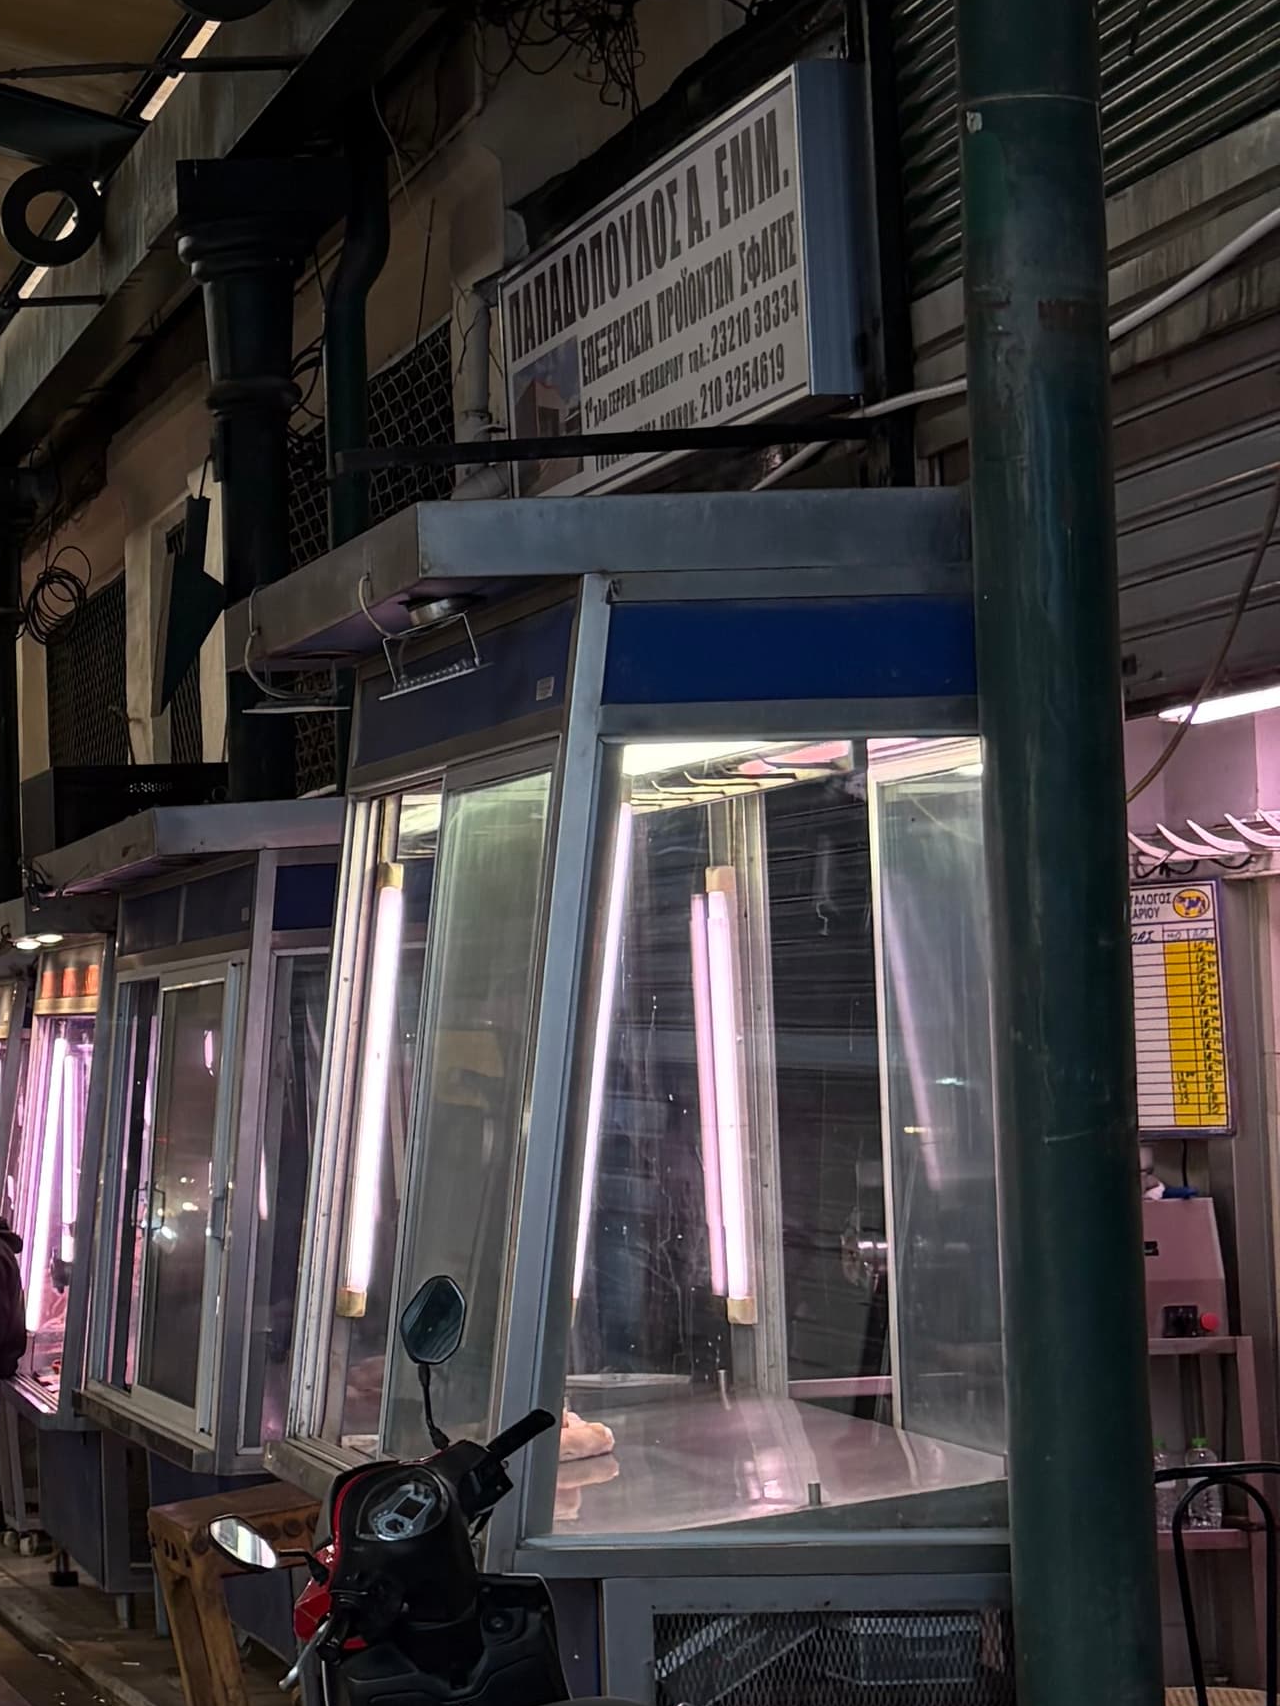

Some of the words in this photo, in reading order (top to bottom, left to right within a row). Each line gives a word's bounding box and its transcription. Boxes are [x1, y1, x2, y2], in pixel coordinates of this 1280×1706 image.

[508, 177, 682, 363] ΠΑΠΑΔΟΠΟΥΛΟΣ
[686, 164, 711, 250] Α.
[714, 108, 790, 230] ΕΜΜ.
[580, 299, 654, 387] ΕΠΕΞΕΡΓΑΣΙΑ
[656, 249, 734, 344] ΠΡΟΪΟΝΤΩΝ
[738, 210, 797, 297] ΣΦΑΓΗΣ
[700, 376, 723, 421] 210
[725, 343, 785, 408] 3254619
[711, 306, 751, 362] 23210
[754, 279, 799, 339] 38334
